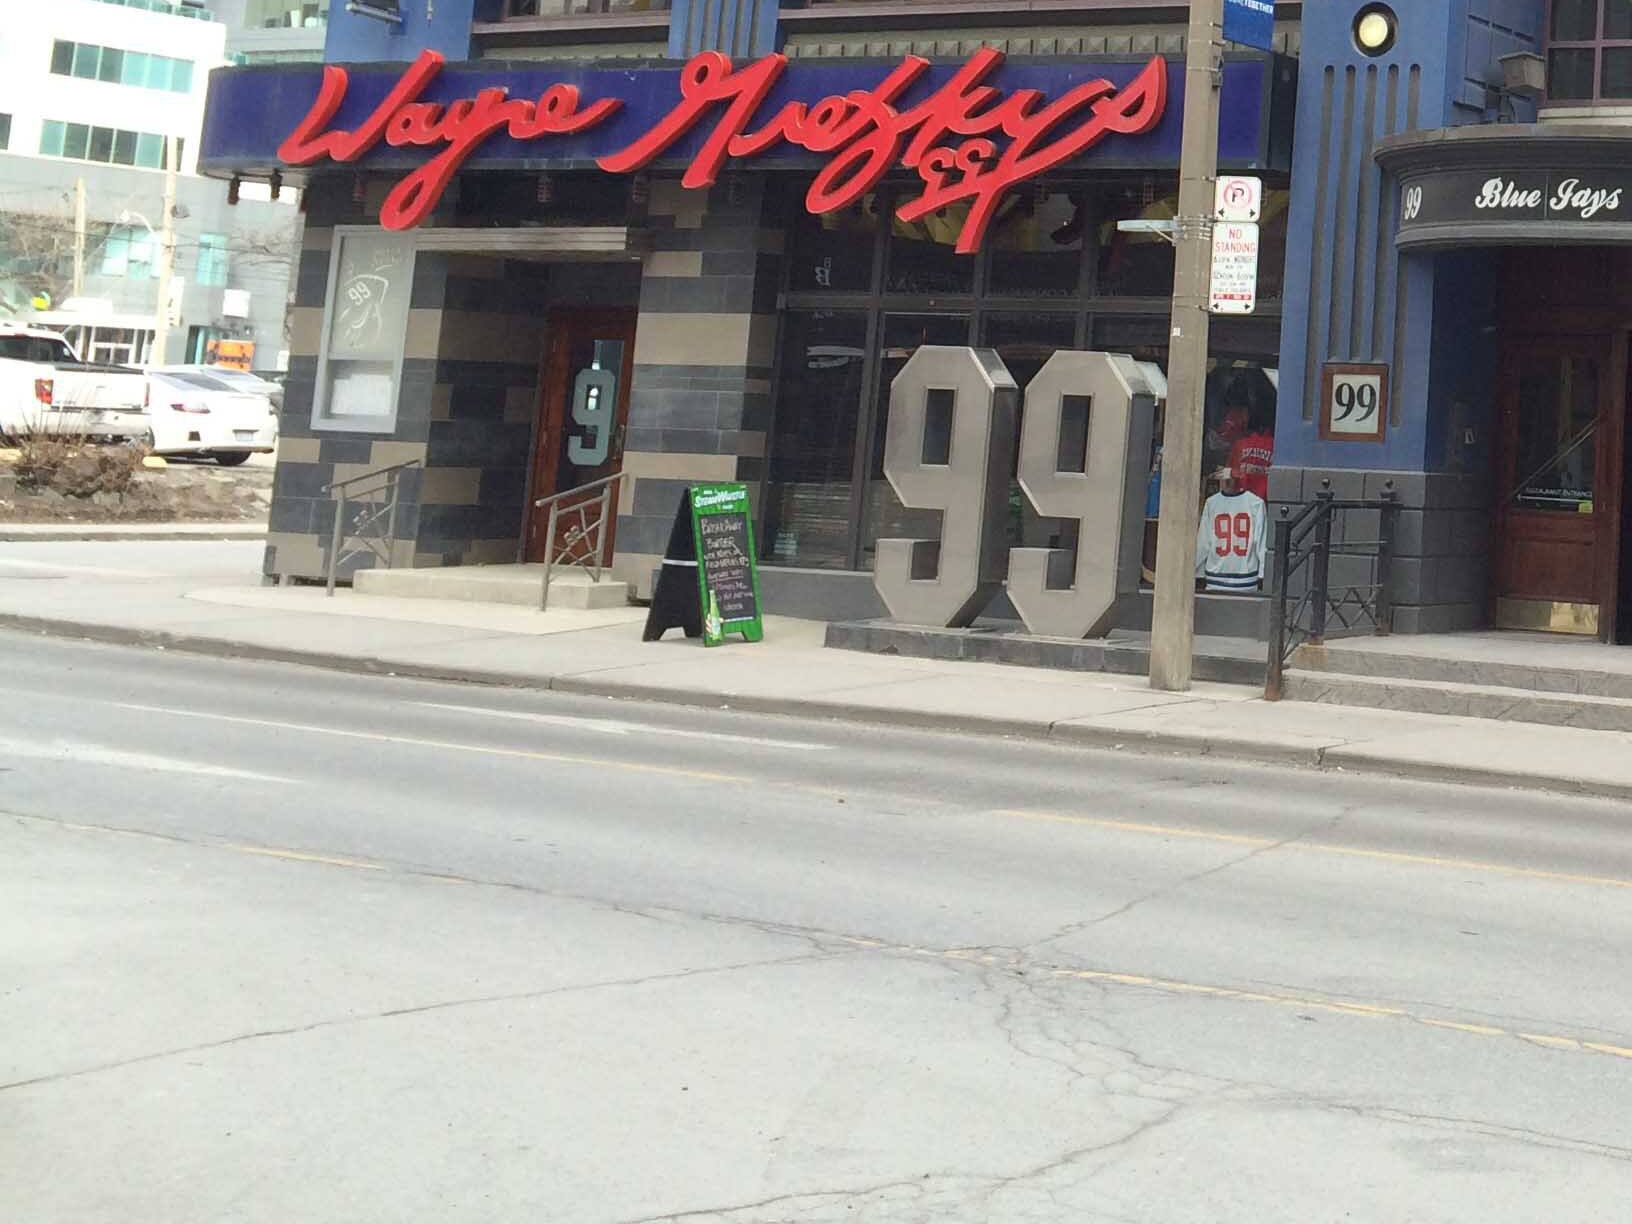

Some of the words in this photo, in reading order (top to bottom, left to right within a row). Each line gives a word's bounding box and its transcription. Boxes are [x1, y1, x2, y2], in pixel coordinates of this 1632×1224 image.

[277, 49, 624, 231] Wayne
[1404, 186, 1422, 219] 99
[1475, 177, 1541, 208] Blue
[1550, 178, 1620, 218] Jays
[1215, 241, 1256, 254] STANDING
[1228, 227, 1243, 240] NO
[1333, 382, 1377, 422] 99
[873, 344, 1146, 638] 99
[1214, 512, 1251, 558] 99
